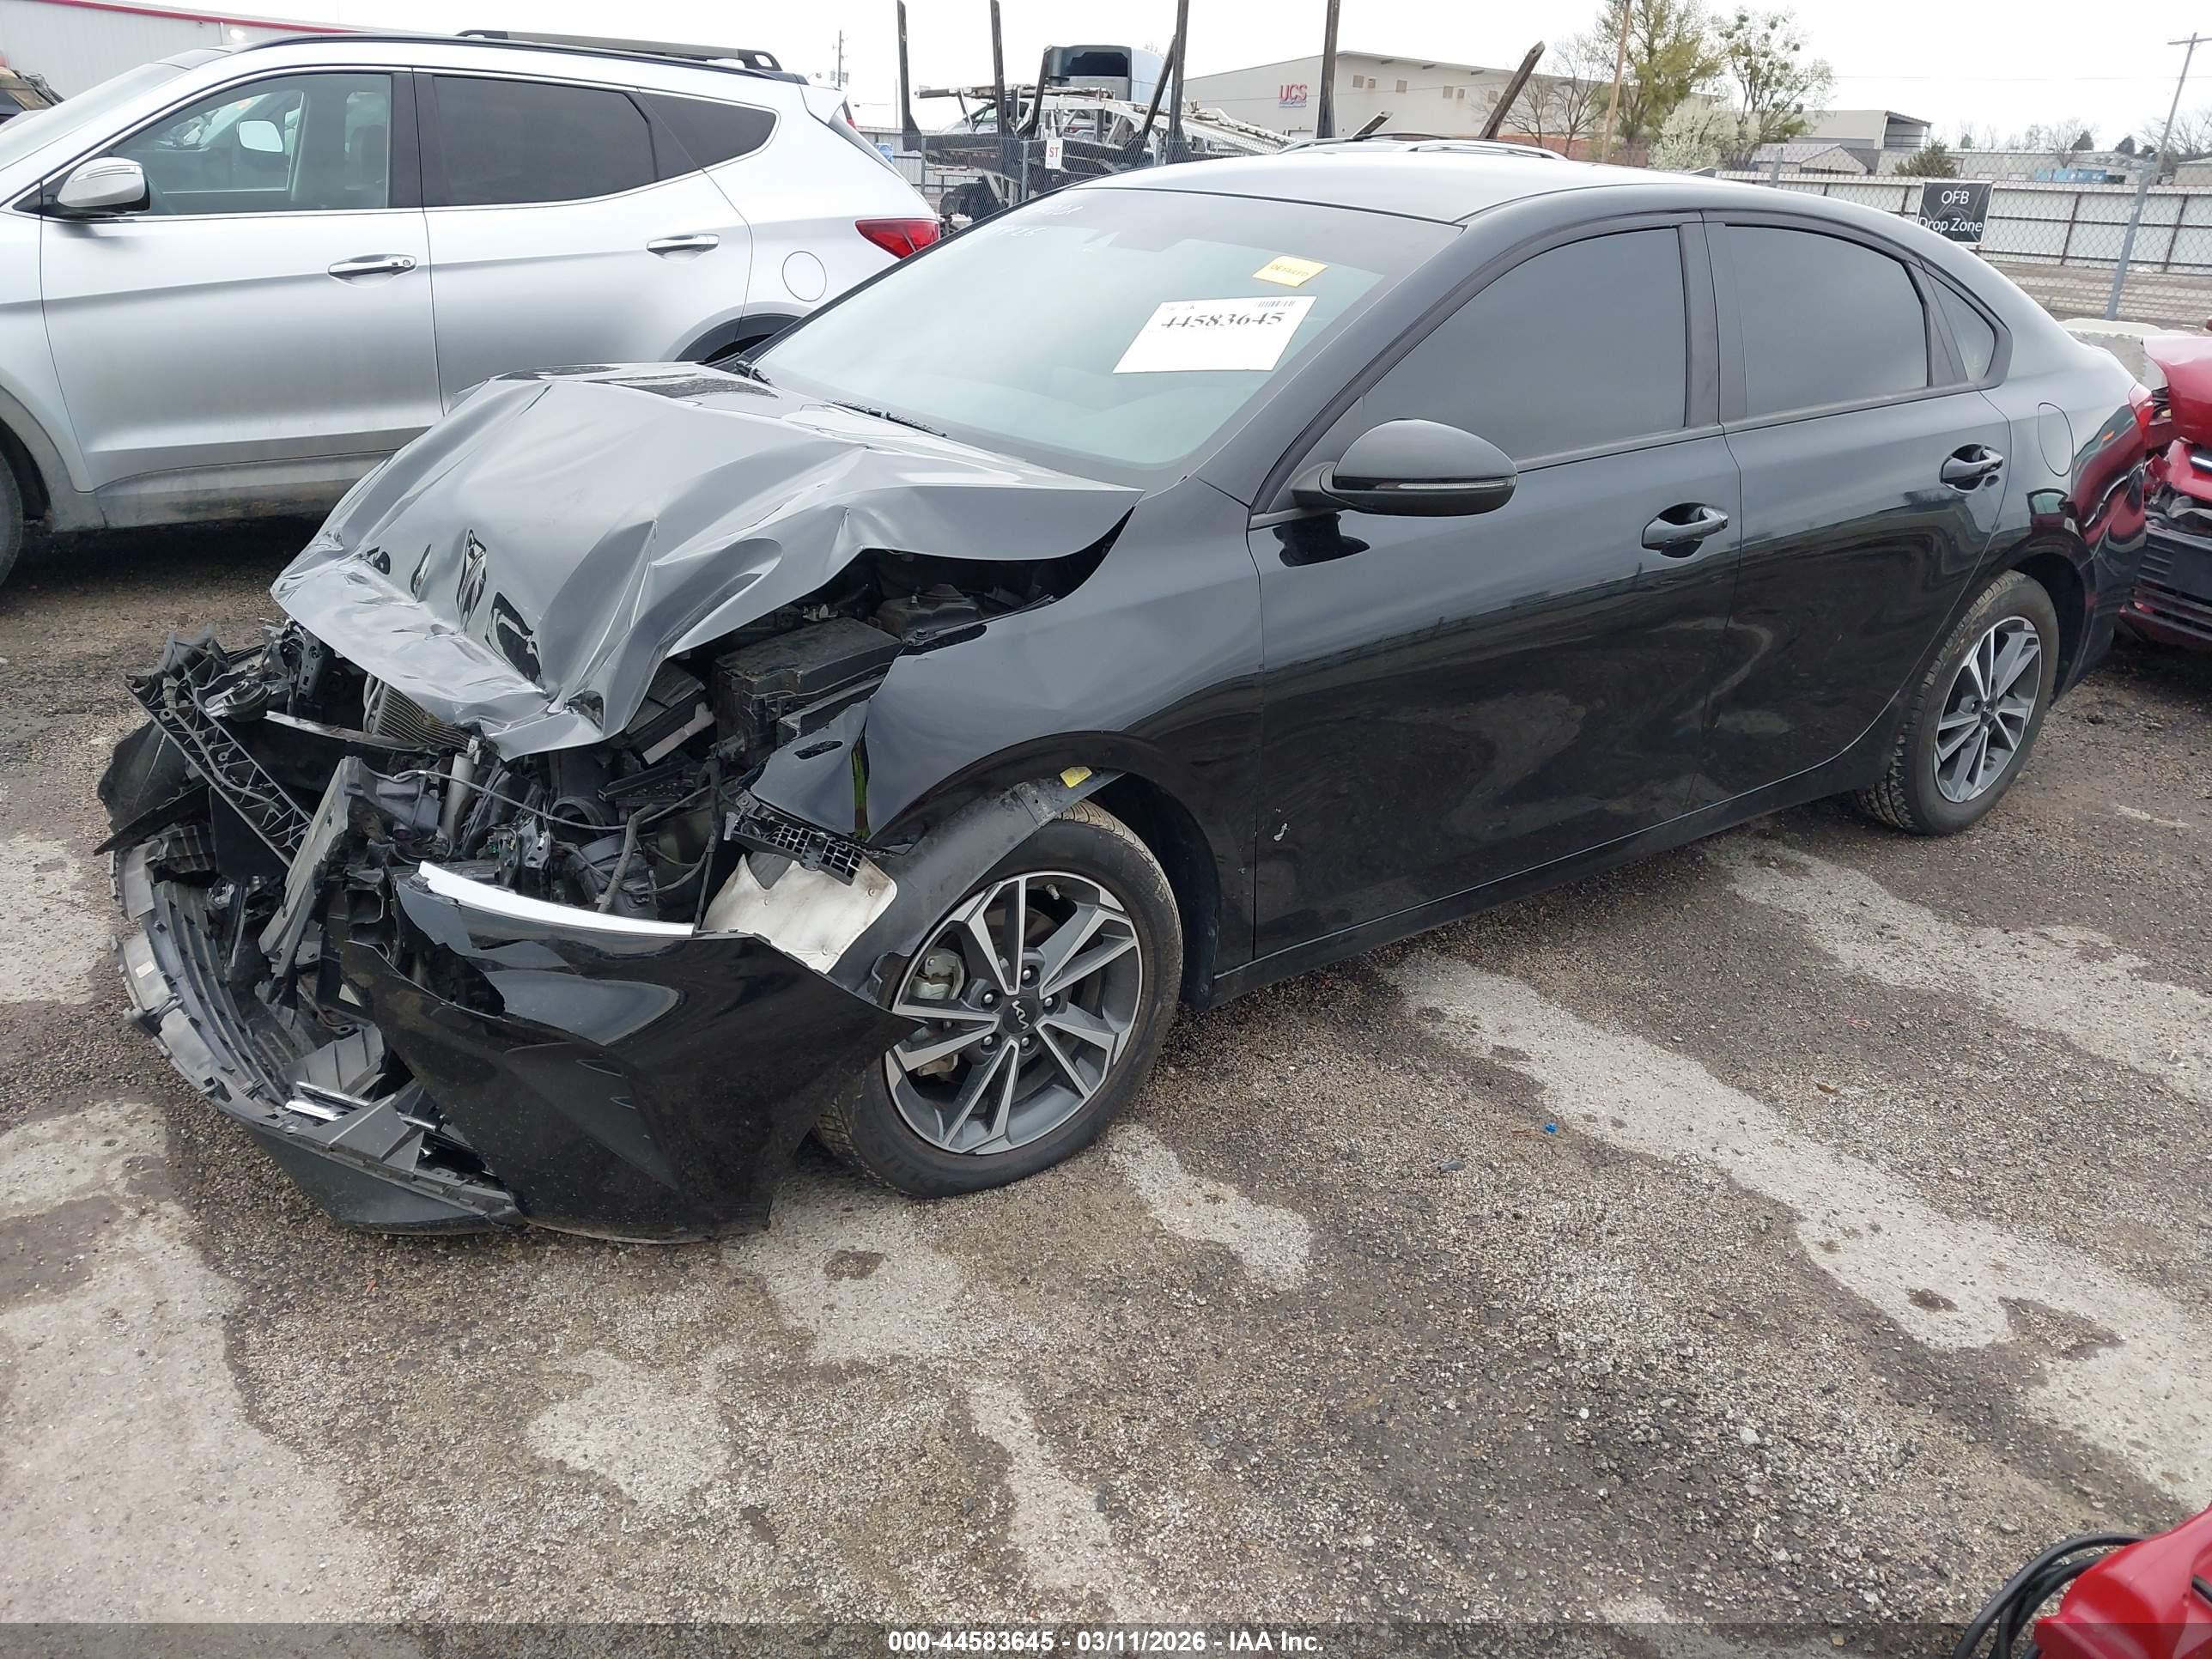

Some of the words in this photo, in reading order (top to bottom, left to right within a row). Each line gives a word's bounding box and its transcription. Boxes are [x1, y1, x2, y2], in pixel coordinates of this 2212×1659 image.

[1278, 84, 1307, 101] UCS
[1048, 146, 1060, 158] ST
[1941, 190, 1970, 204] OFB
[1918, 216, 1948, 234] Drop
[1949, 217, 1984, 233] Zone
[1161, 311, 1285, 329] 44583645
